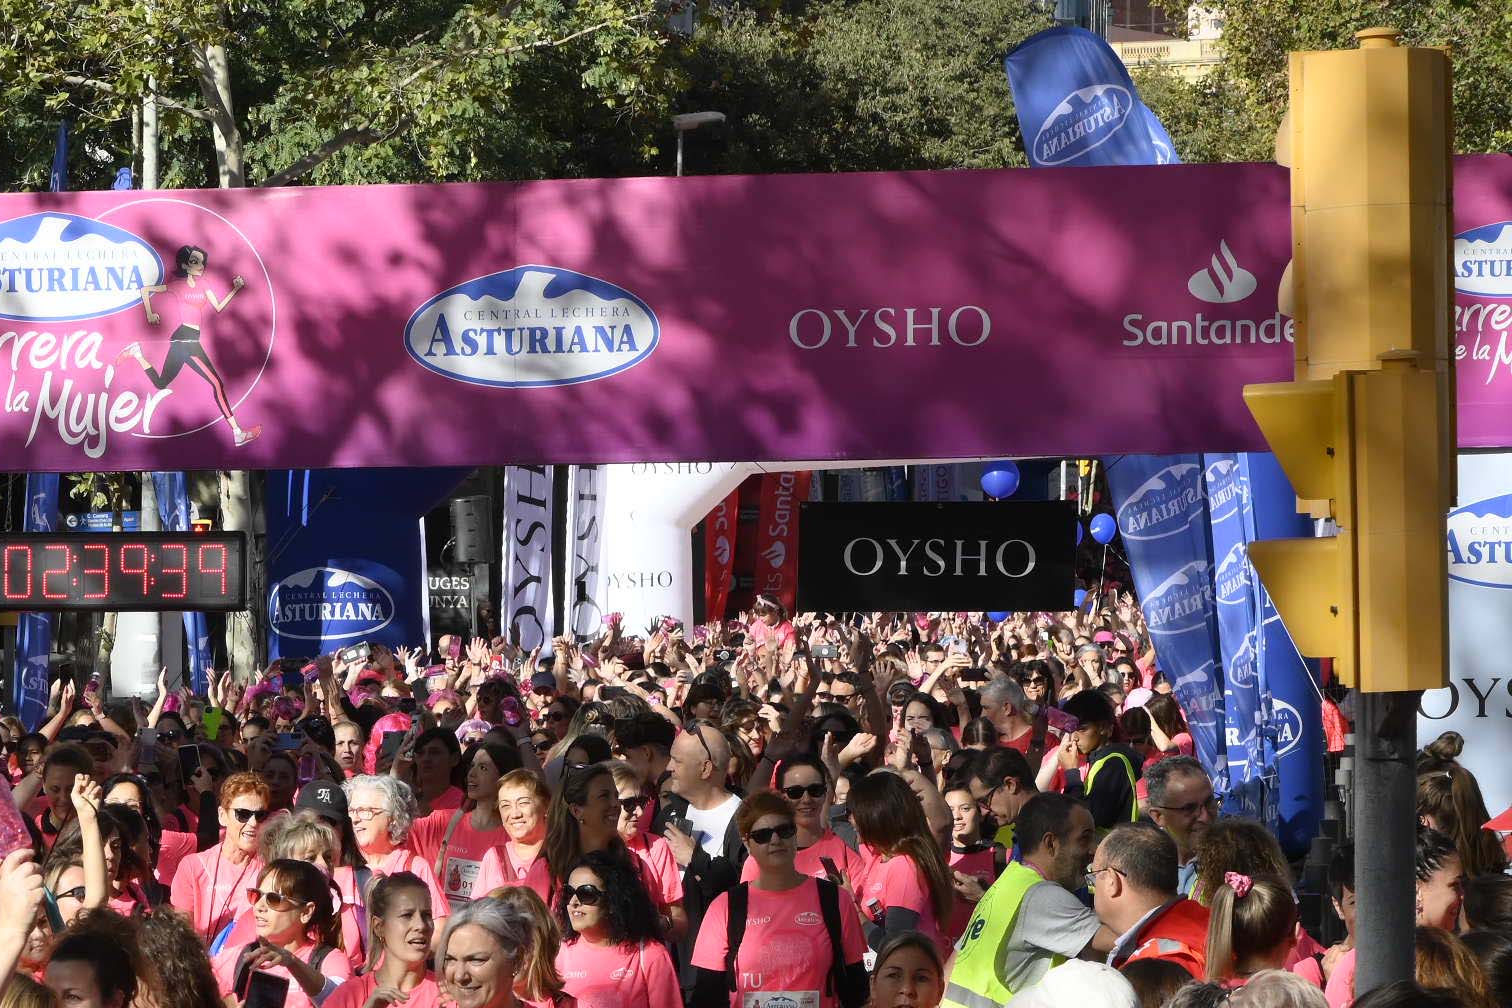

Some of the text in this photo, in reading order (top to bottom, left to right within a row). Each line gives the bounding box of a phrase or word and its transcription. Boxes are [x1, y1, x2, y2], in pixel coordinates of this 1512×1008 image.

[464, 306, 631, 320] CENTRAL LECHERA
[789, 306, 991, 349] OYSHO
[1122, 312, 1294, 346] Santande
[424, 313, 639, 356] ASTURIANA
[5, 372, 29, 413] la
[24, 367, 172, 458] Mujer
[3, 543, 228, 599] 02:39:39
[842, 537, 1036, 578] OYSHO
[273, 597, 385, 623] ASTURIANA
[333, 591, 381, 599] LECHERA
[746, 916, 771, 926] YSHO
[743, 973, 762, 988] TU
